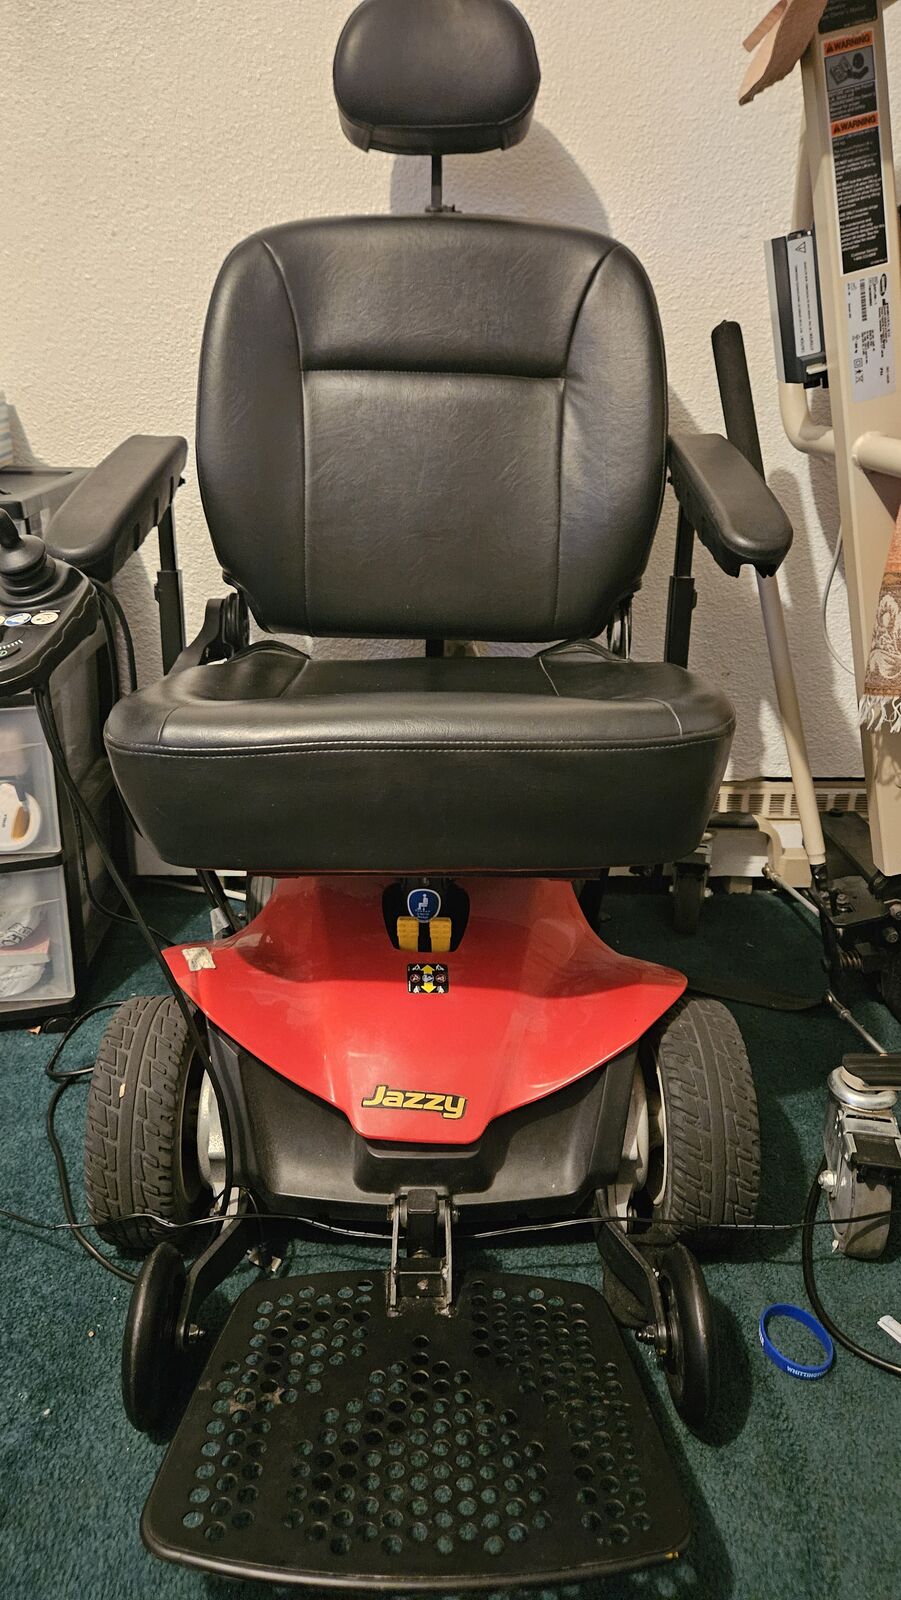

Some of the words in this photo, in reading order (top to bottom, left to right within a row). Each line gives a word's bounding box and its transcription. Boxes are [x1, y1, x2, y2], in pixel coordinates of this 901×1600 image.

[834, 34, 870, 50] WARNING
[841, 115, 876, 131] WARNING
[361, 1085, 467, 1120] Jazzy
